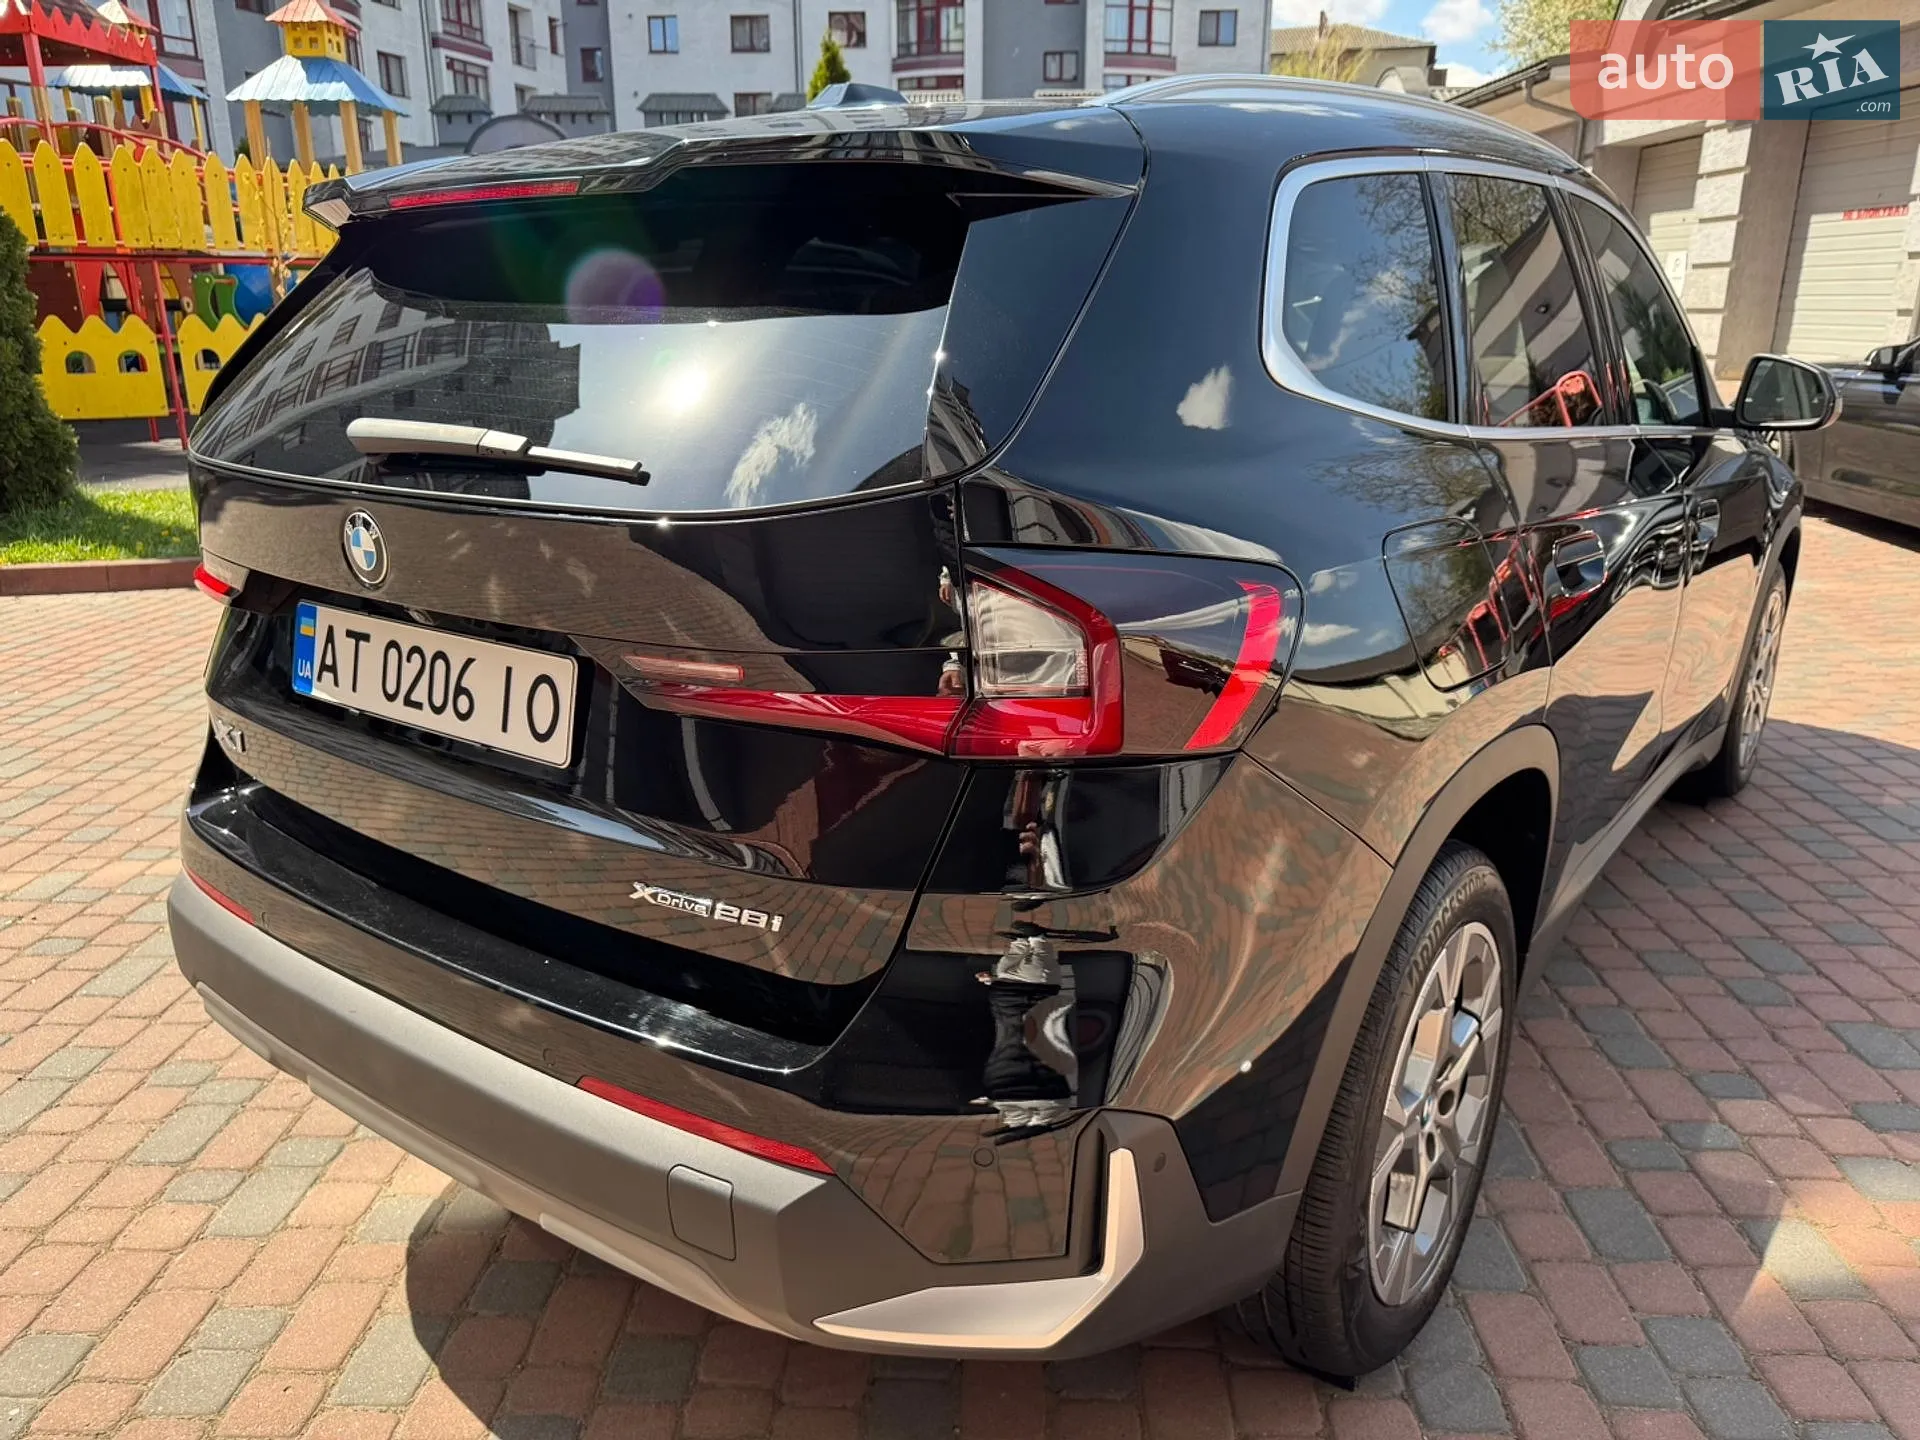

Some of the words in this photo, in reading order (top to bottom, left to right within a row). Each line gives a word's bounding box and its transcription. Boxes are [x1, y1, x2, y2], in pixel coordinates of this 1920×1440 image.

[297, 657, 312, 680] UA
[316, 624, 371, 694] AT
[381, 639, 477, 722] 0206
